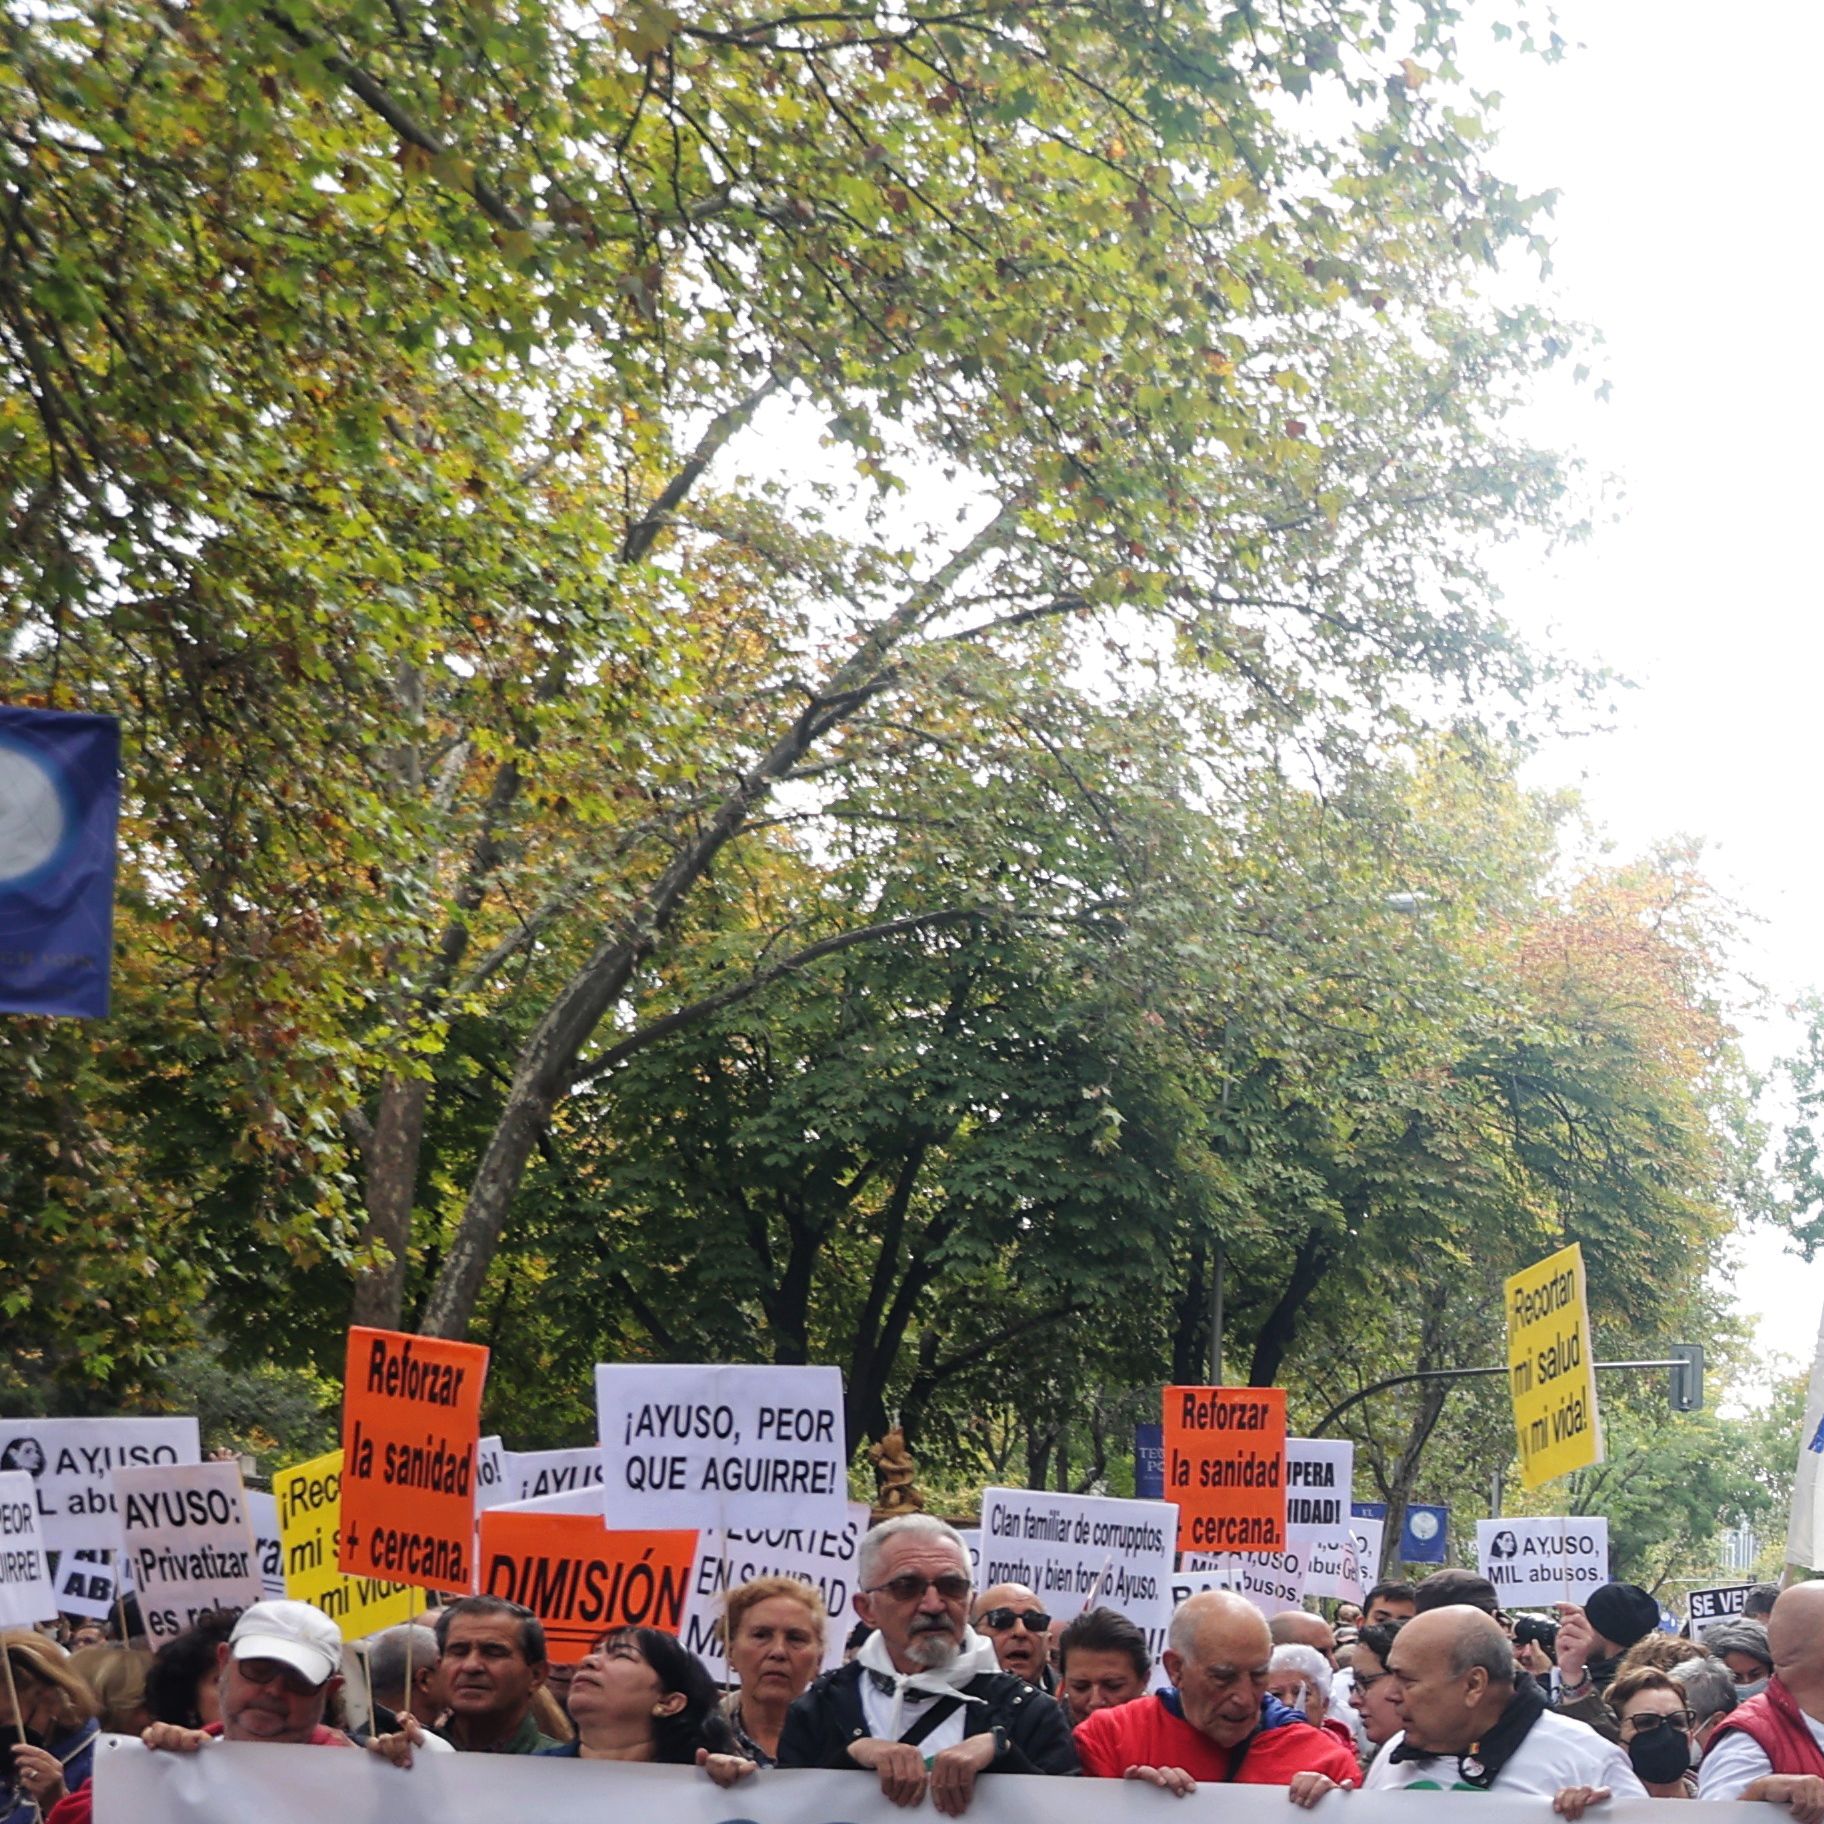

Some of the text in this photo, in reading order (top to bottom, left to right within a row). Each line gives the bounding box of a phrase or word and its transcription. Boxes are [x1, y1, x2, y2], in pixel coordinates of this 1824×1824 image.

[367, 1338, 466, 1407] Reforzar
[1513, 1321, 1581, 1398] mi salud
[625, 1403, 835, 1446] ¡AYUSO, PEOR
[1181, 1392, 1269, 1431] Reforzar
[1519, 1385, 1588, 1472] y mi vida!
[351, 1420, 373, 1480] la
[383, 1434, 473, 1497] sanidad
[625, 1455, 837, 1495] QUE AGUIRRE!
[1170, 1448, 1190, 1487] la
[1199, 1450, 1281, 1488] sanidad
[126, 1489, 242, 1531] AYUSO:
[991, 1503, 1020, 1536] Clan
[1023, 1506, 1071, 1542] familiar
[1074, 1512, 1091, 1545] de
[1191, 1516, 1280, 1545] cercana.
[134, 1546, 249, 1593] ¡Privatizar
[371, 1526, 467, 1584] cercana.
[696, 1556, 736, 1595] EN
[1487, 1565, 1604, 1584] MIL abusos.
[485, 1548, 693, 1627] DIMISIÓN
[987, 1560, 1031, 1587] pronto
[1034, 1567, 1043, 1594] y
[1044, 1560, 1074, 1592] bien
[1115, 1566, 1159, 1605] Ayuso.
[149, 1608, 181, 1638] es
[1692, 1594, 1715, 1617] SE
